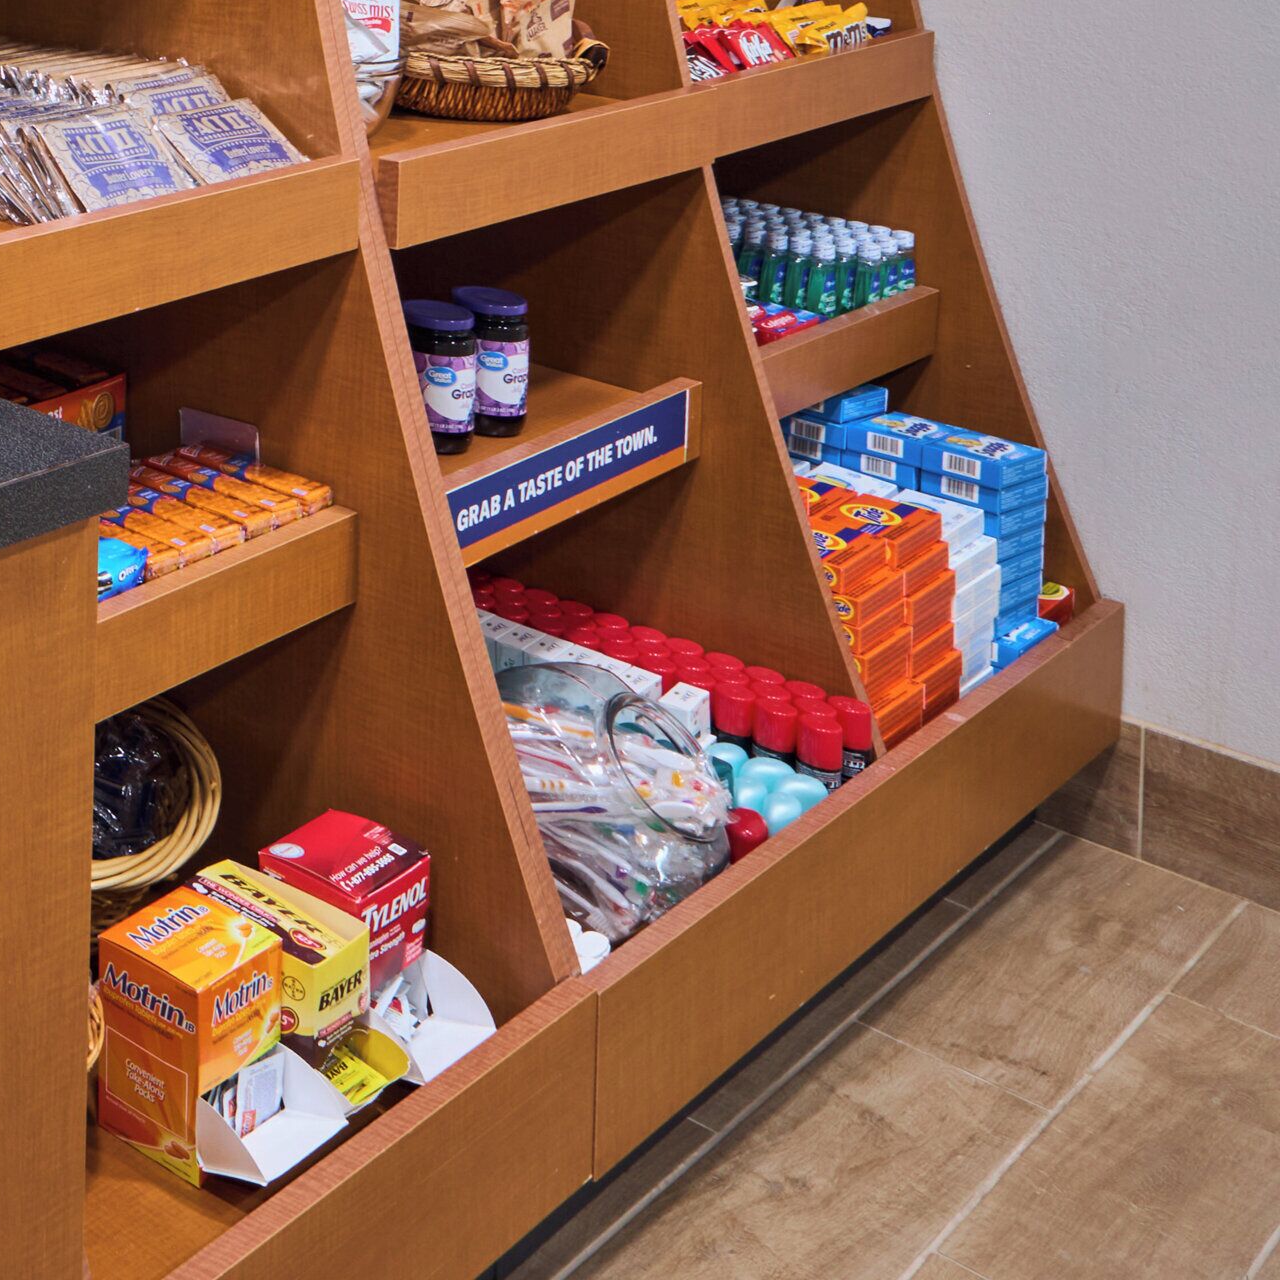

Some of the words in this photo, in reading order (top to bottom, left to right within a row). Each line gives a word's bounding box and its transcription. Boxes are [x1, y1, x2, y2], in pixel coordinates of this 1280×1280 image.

[193, 117, 227, 135] ACT
[227, 113, 249, 129] II
[76, 134, 110, 155] ACT
[113, 129, 136, 149] II
[428, 370, 452, 380] Great
[480, 355, 503, 365] Great
[456, 492, 501, 531] GRAB
[503, 488, 516, 508] A
[518, 467, 563, 504] TASTE
[565, 457, 584, 482] OF
[586, 444, 613, 472] THE
[615, 425, 657, 461] TOWN.
[852, 507, 885, 524] Tide
[329, 869, 345, 883] How
[344, 862, 358, 874] can
[357, 855, 368, 866] we
[364, 845, 383, 861] help?
[361, 878, 427, 933] TYLENOL
[126, 905, 200, 950] Motrin
[103, 962, 185, 1028] Motrin
[184, 1020, 196, 1034] IB
[211, 970, 267, 1028] Motrin
[318, 969, 363, 1012] BAYER
[125, 1058, 165, 1090] Convenient
[126, 1069, 165, 1100] Take-Along
[134, 1084, 156, 1103] Packs
